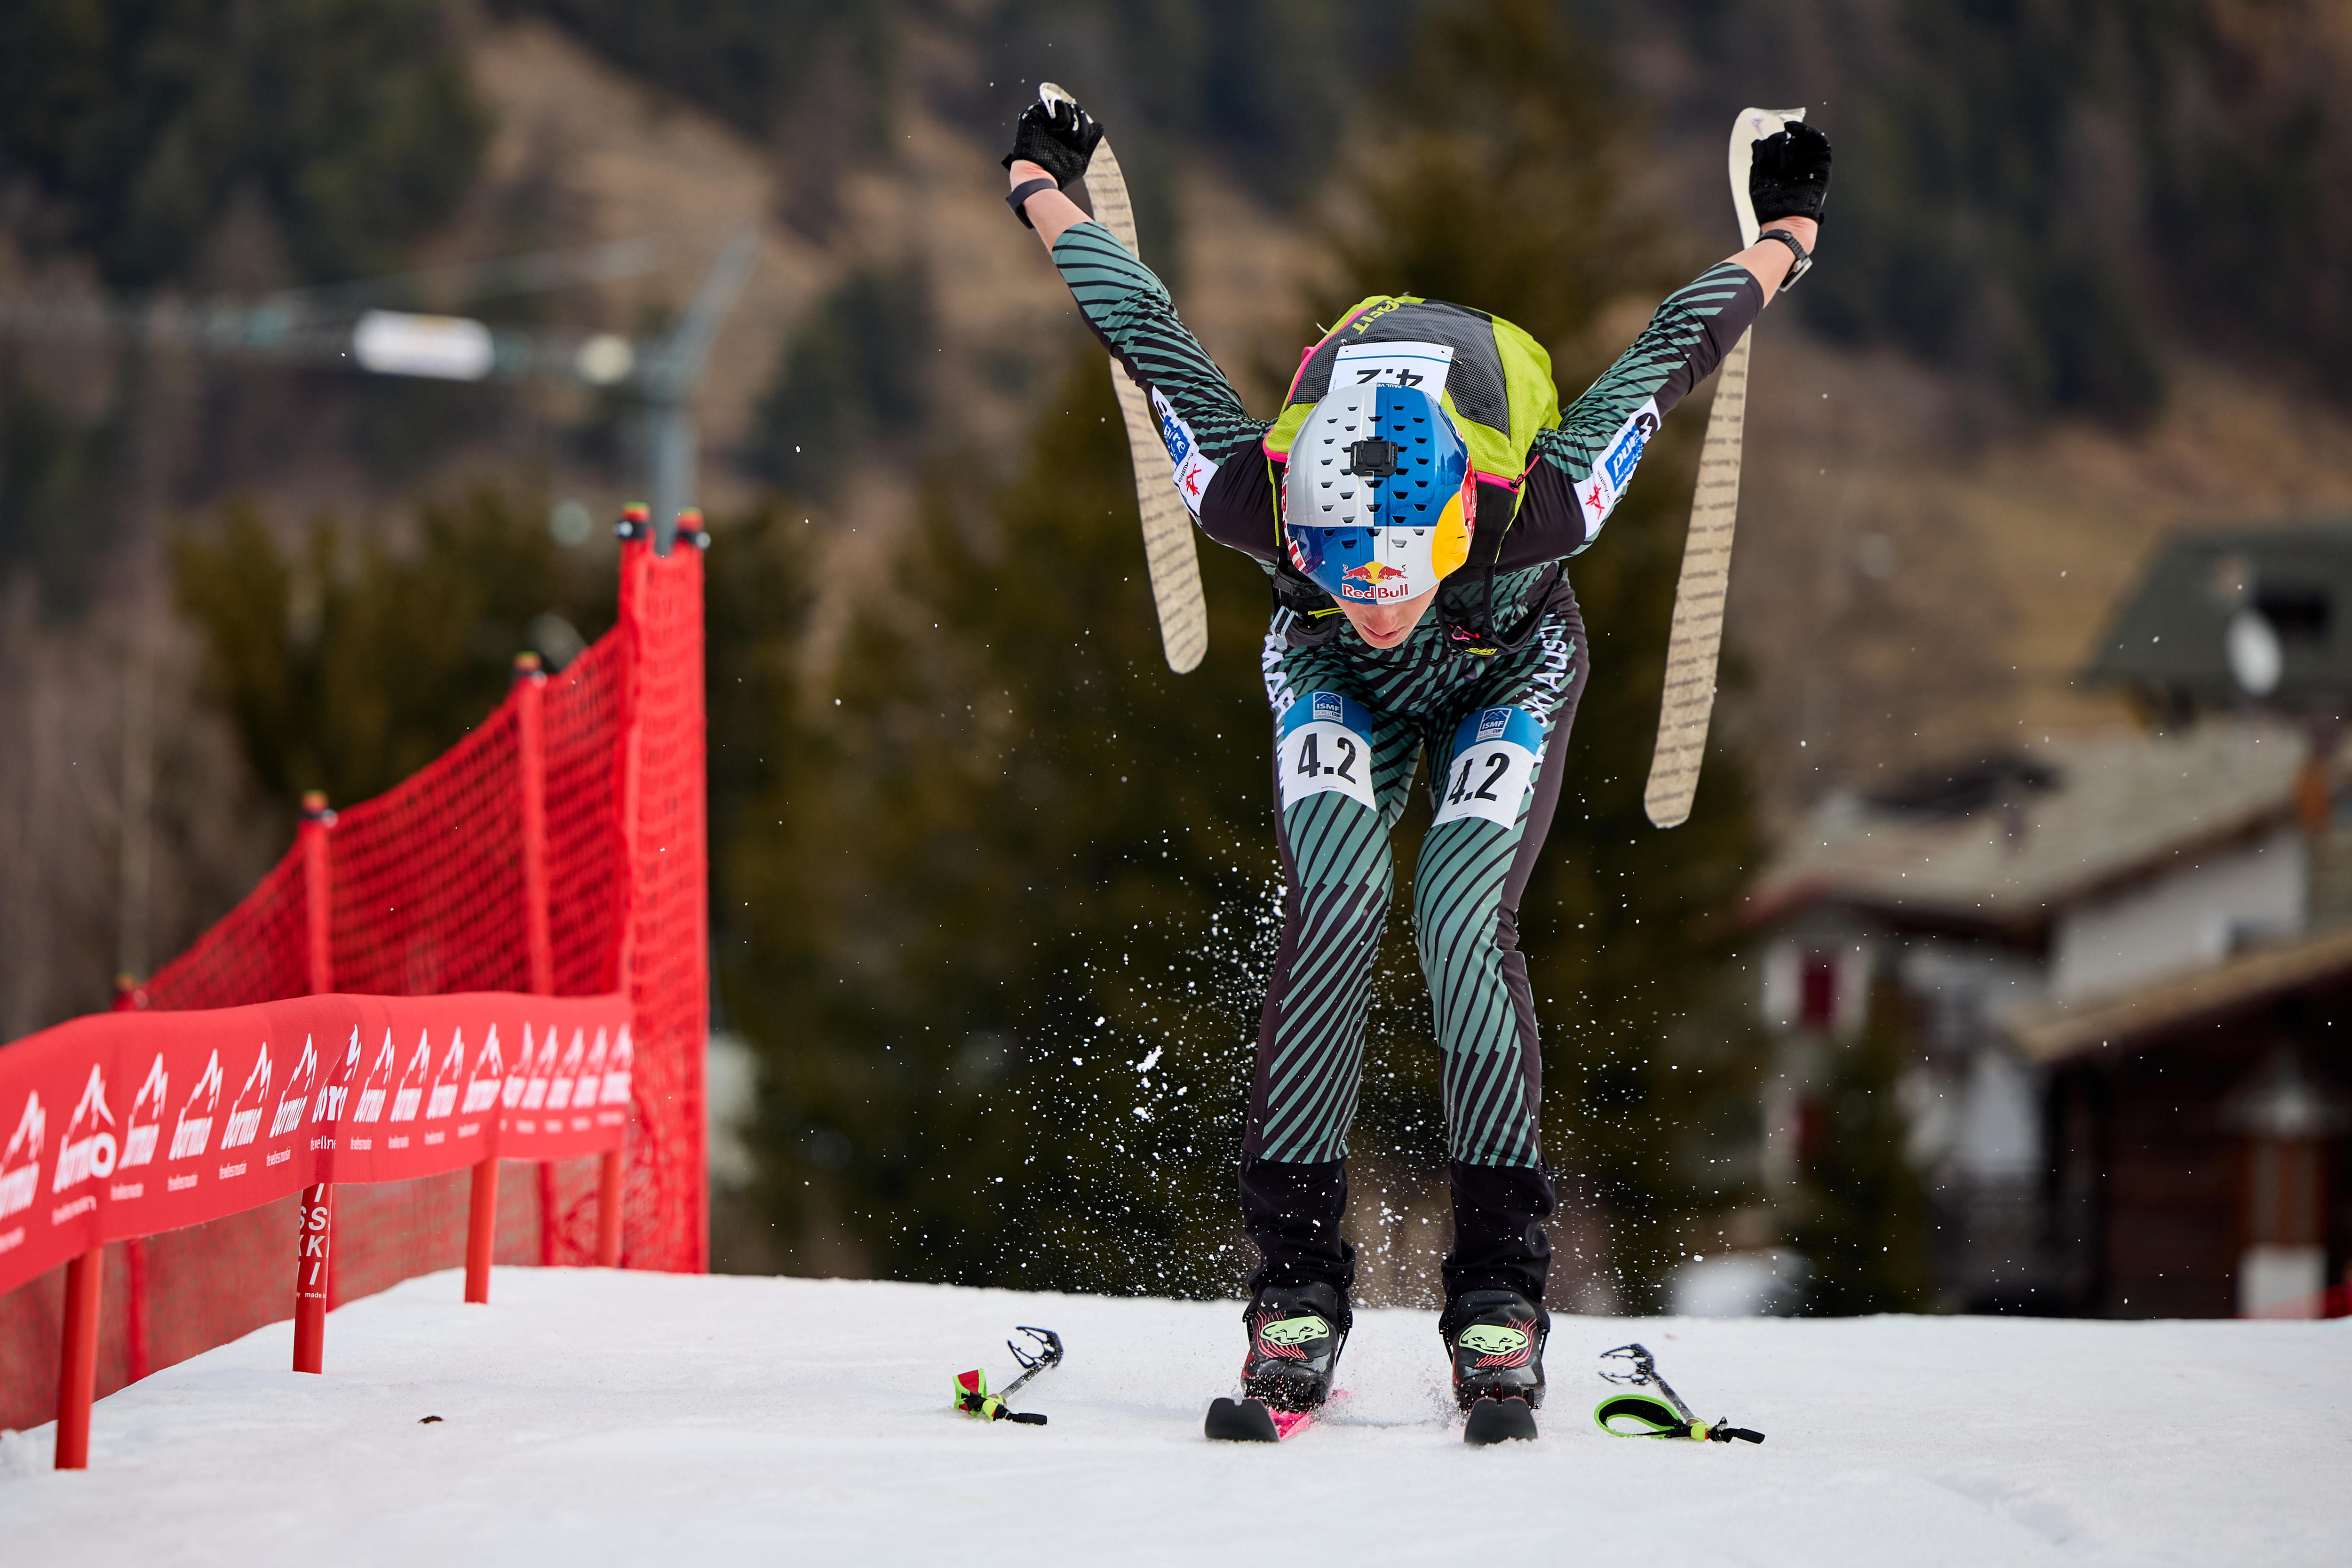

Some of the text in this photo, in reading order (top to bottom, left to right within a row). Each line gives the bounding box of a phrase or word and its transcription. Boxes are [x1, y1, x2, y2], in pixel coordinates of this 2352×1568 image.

[1343, 584, 1408, 599] Red Bull
[1317, 703, 1340, 711] ISMF
[1482, 720, 1504, 730] ISMF
[1298, 732, 1356, 785] 4.2
[1447, 753, 1510, 805] 4.2
